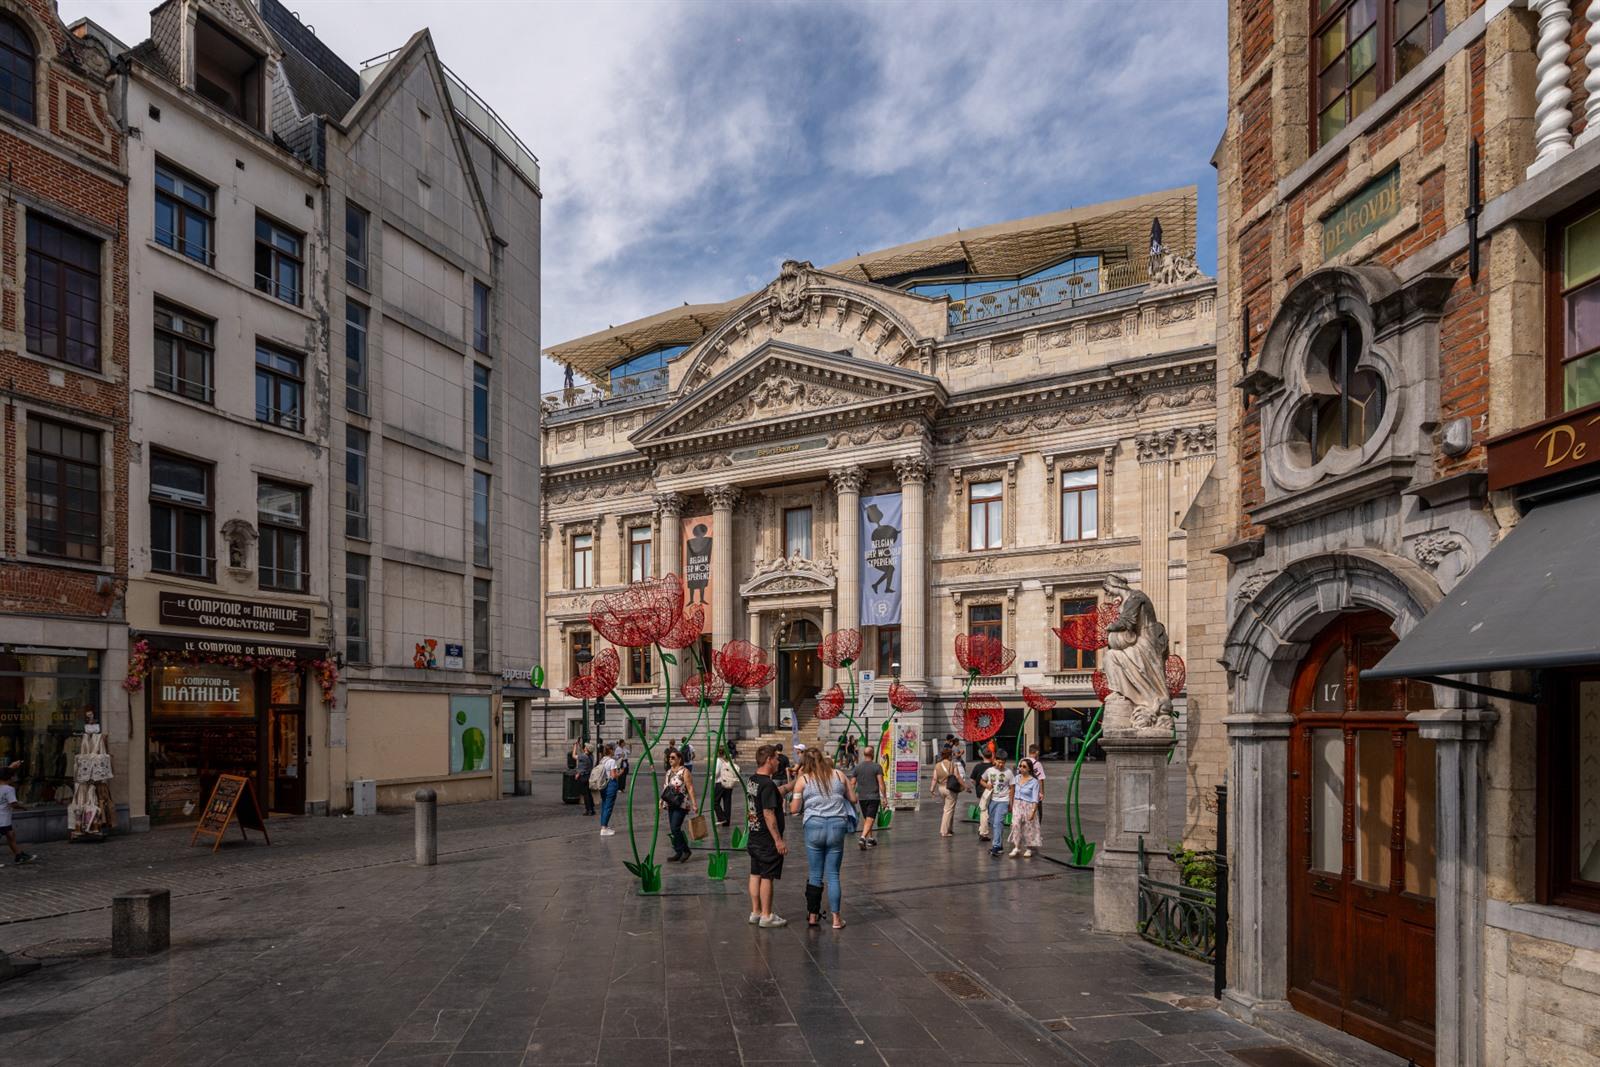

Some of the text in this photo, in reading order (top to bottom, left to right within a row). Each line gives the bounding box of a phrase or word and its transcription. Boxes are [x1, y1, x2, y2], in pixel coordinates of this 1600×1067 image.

[1535, 424, 1587, 469] De
[872, 538, 895, 549] BELGIAN
[177, 598, 298, 622] LE COMPTOIR DE MATHILDE
[199, 615, 275, 632] CHOCOLATERIE
[185, 641, 297, 658] LE COMPTOIR DE MATHILDE
[183, 677, 221, 686] COMPTOIR
[162, 685, 240, 702] MATHILDE
[1324, 683, 1340, 702] 17
